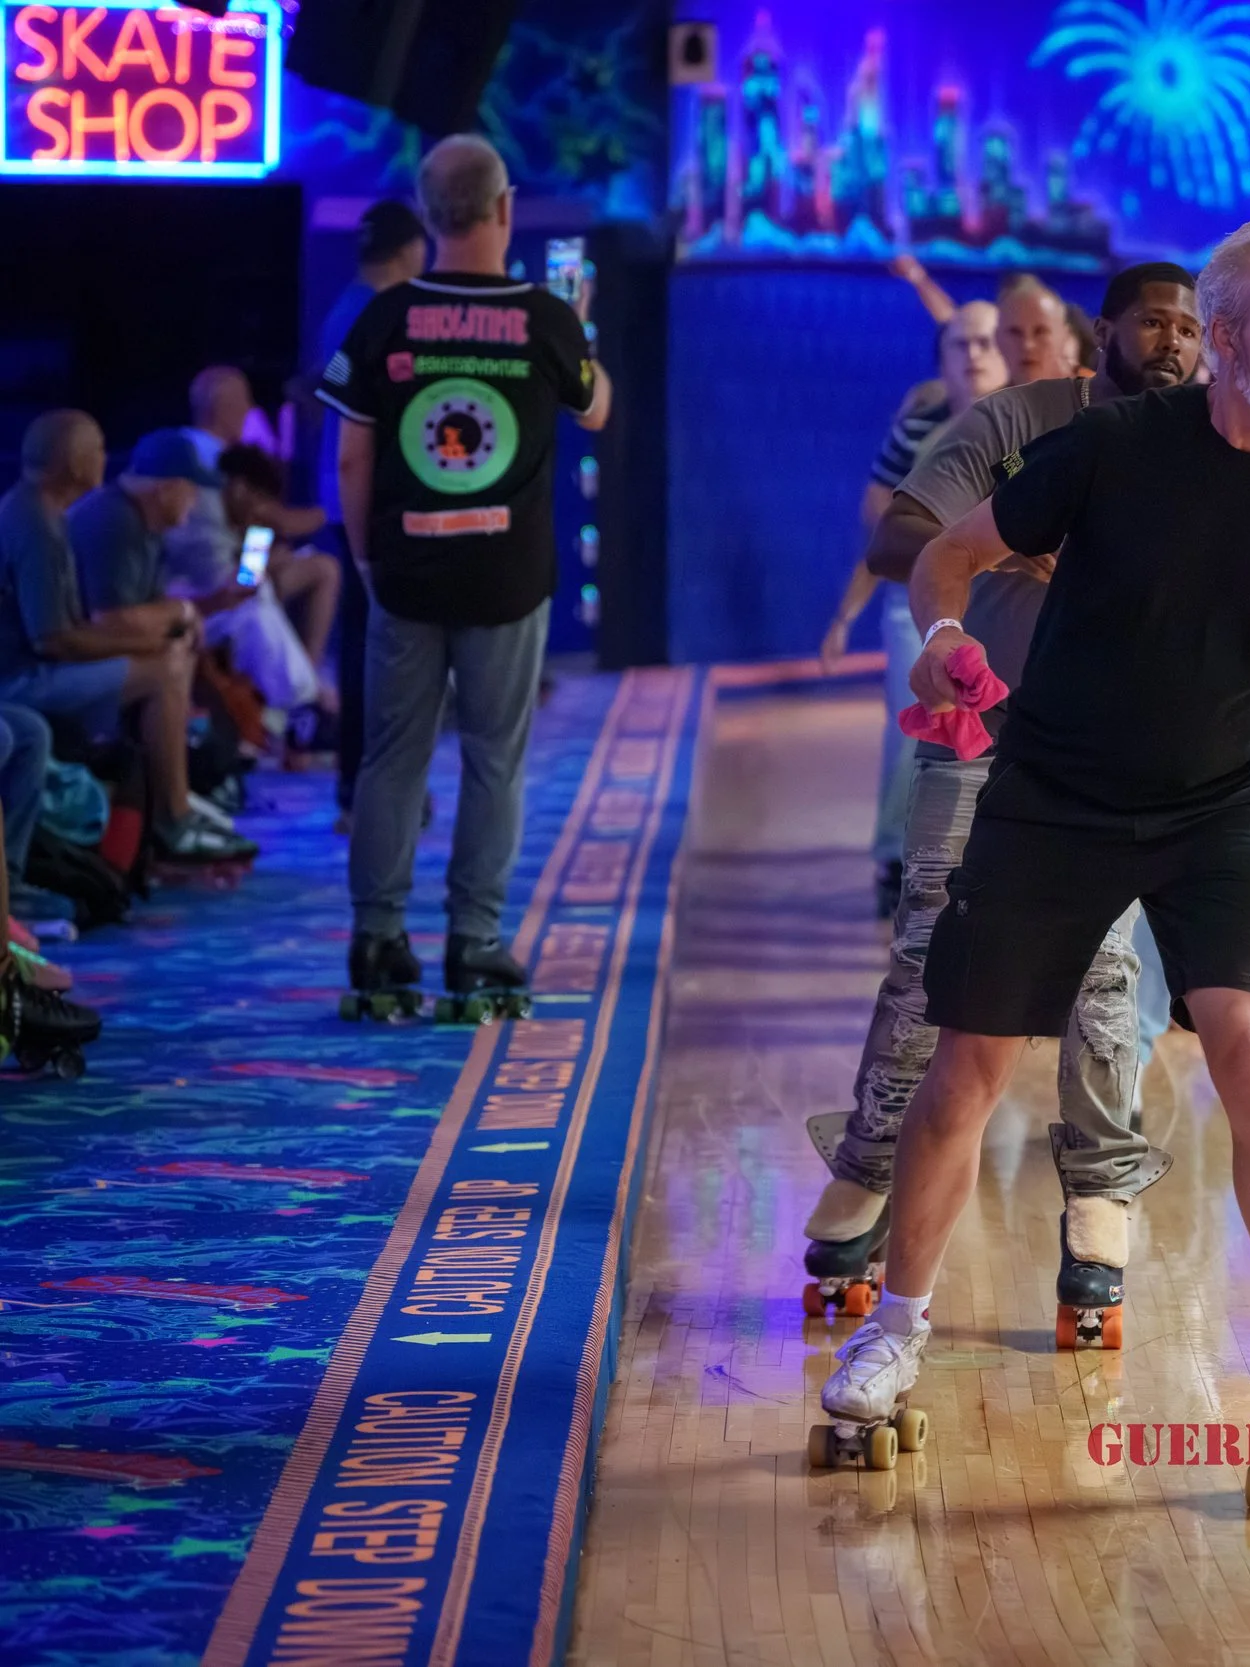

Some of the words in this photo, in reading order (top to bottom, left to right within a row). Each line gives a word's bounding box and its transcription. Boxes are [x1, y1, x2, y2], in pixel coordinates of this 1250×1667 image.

[14, 5, 261, 89] SKATE
[27, 87, 253, 164] SHOP
[432, 1205, 532, 1240] STEP
[449, 1179, 540, 1200] UP
[400, 1246, 522, 1315] CAUTION
[334, 1391, 477, 1488] CAUTION
[309, 1499, 448, 1564] STEP
[267, 1577, 427, 1667] DOWN
